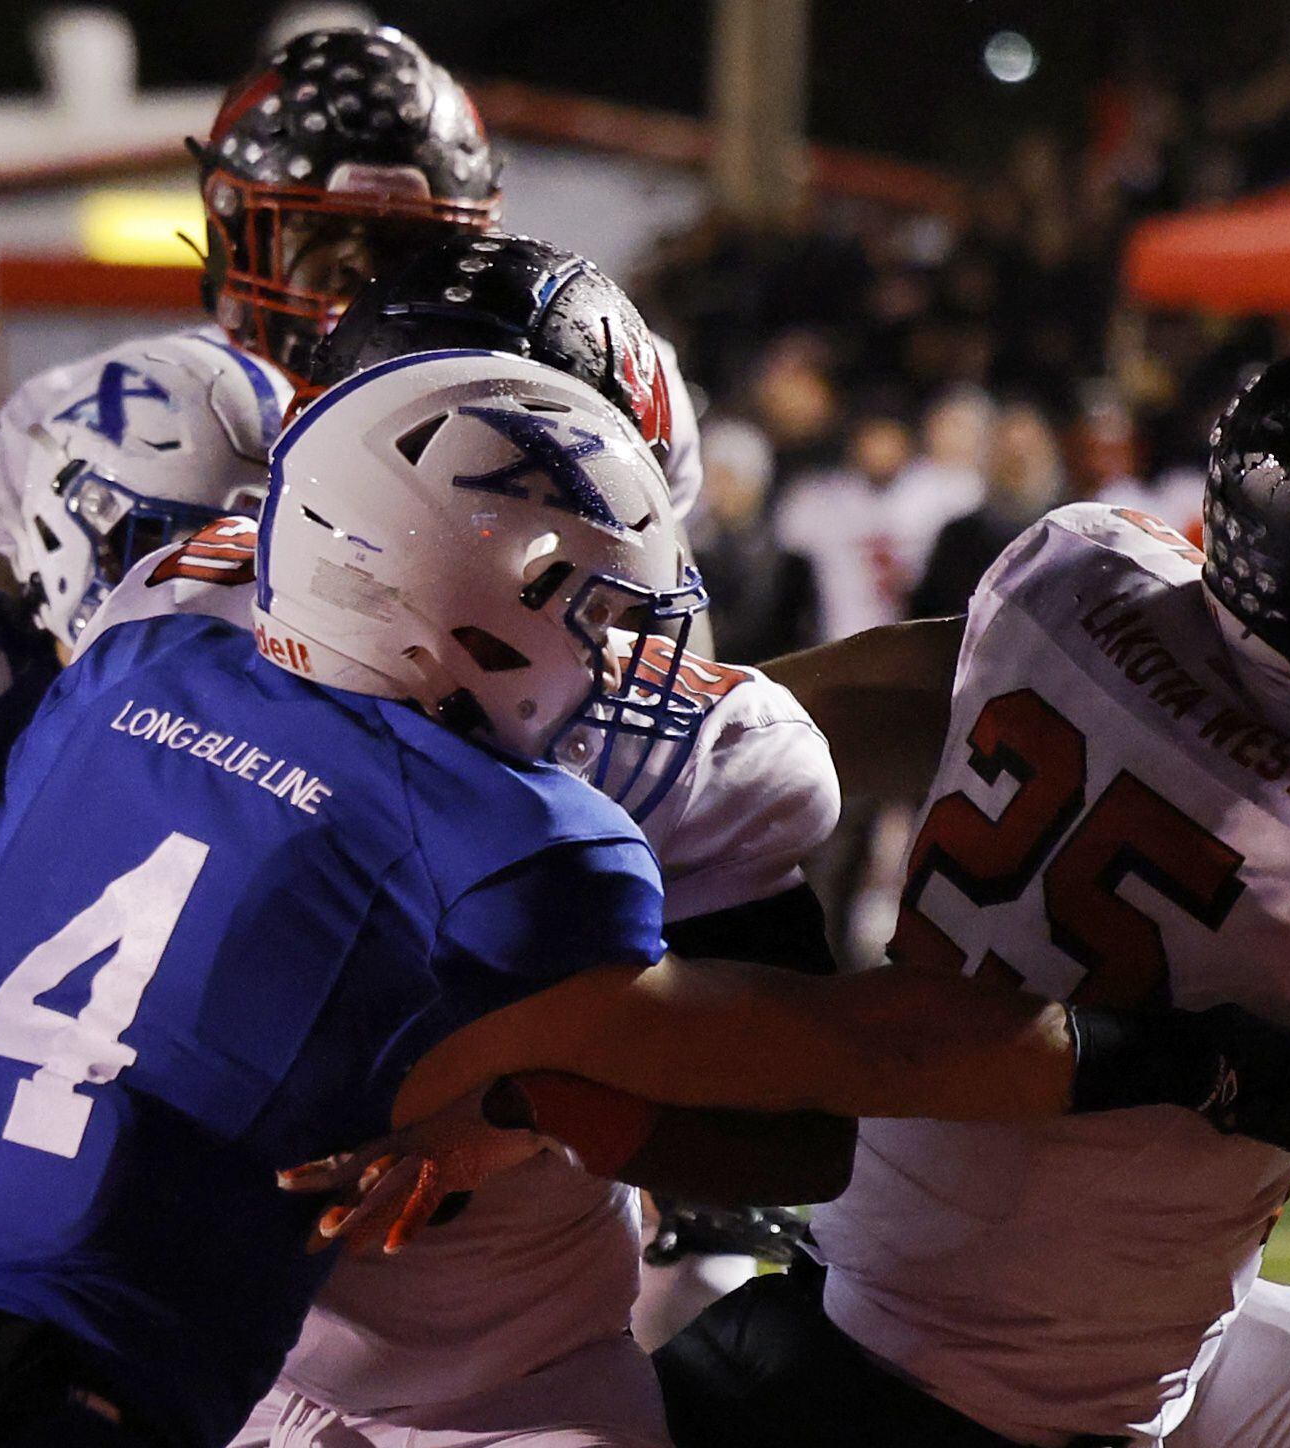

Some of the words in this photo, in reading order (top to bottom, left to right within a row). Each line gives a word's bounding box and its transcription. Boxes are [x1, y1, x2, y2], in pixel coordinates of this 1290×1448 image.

[1081, 592, 1210, 721] LAKOTA
[110, 700, 200, 750] LONG
[189, 731, 271, 781] BLUE
[258, 759, 333, 815] LINE
[882, 688, 1247, 1012] 25
